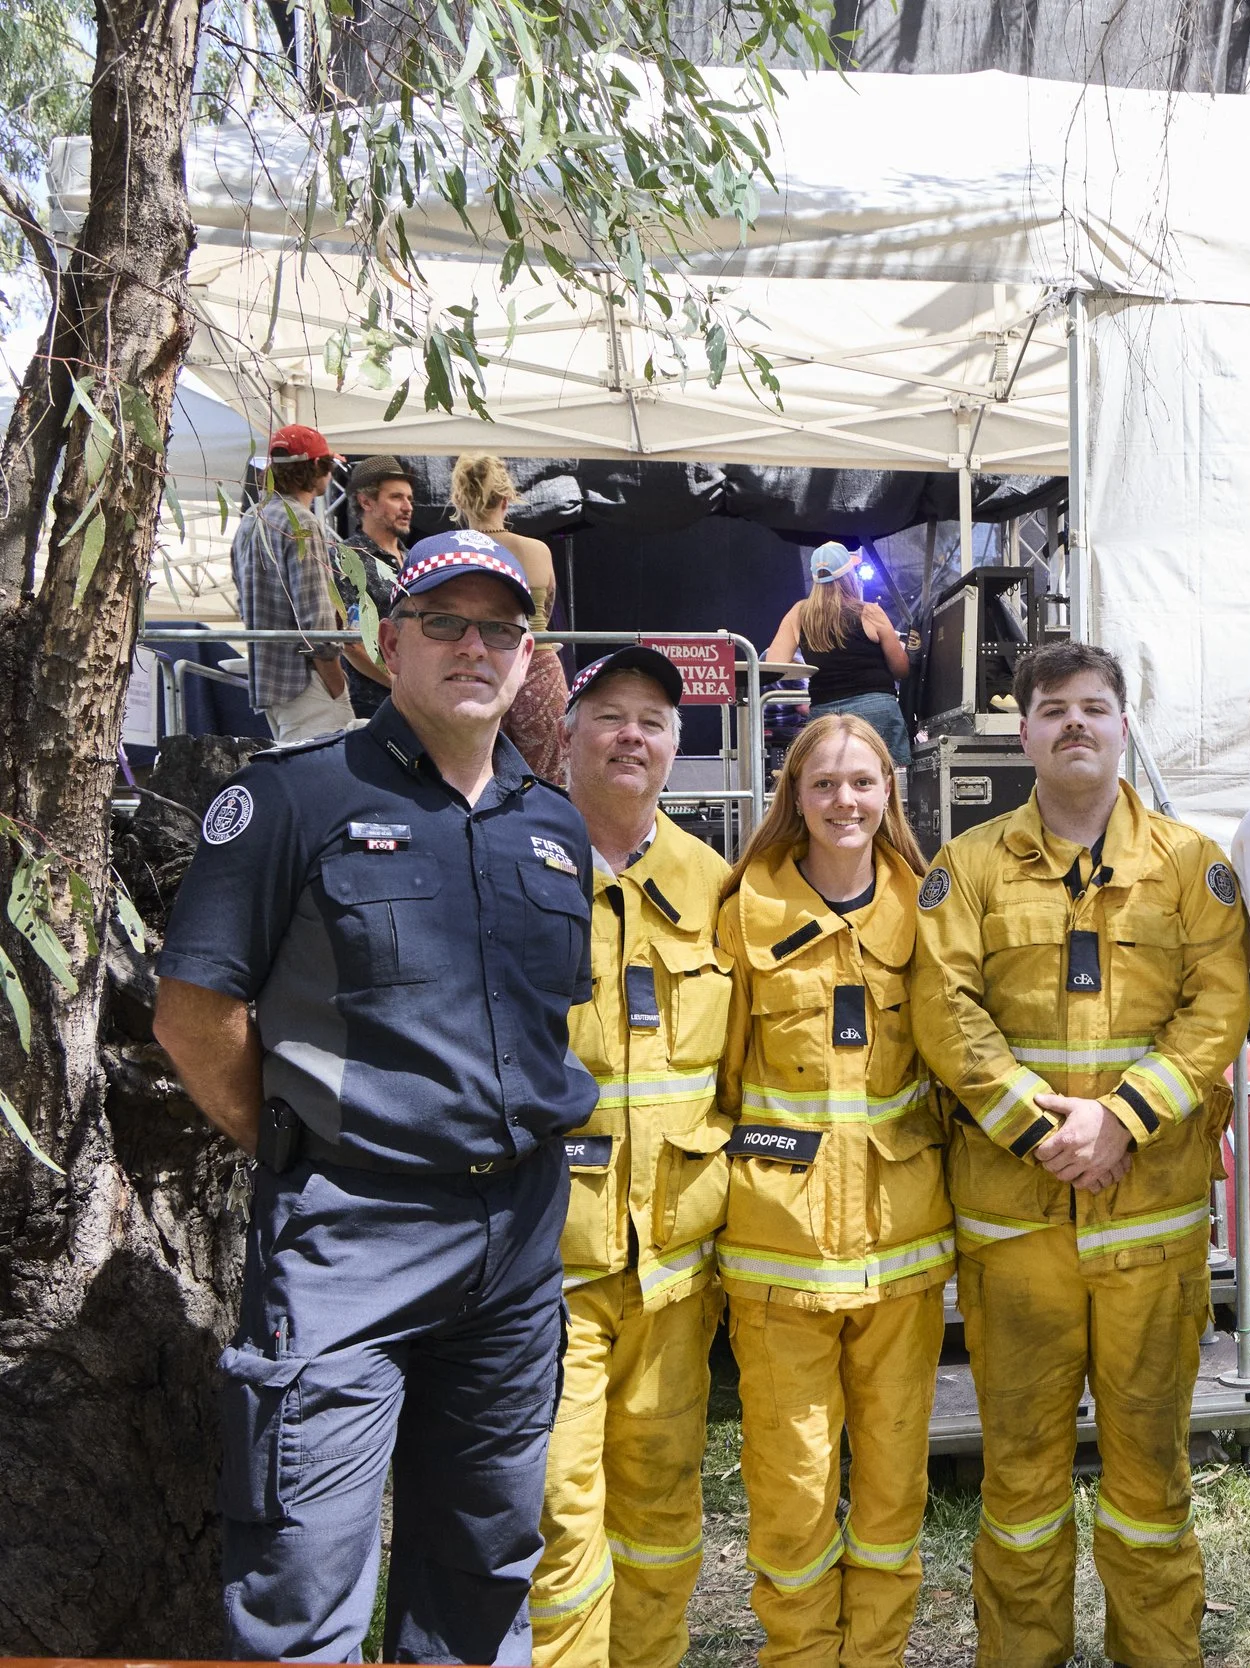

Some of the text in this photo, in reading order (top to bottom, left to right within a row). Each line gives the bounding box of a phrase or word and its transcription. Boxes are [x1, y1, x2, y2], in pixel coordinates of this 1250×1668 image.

[677, 665, 730, 680] TIVAL
[681, 681, 730, 696] AREA
[207, 829, 231, 841] VICTORIA
[743, 1132, 798, 1151] HOOPER
[564, 1144, 585, 1156] ER
